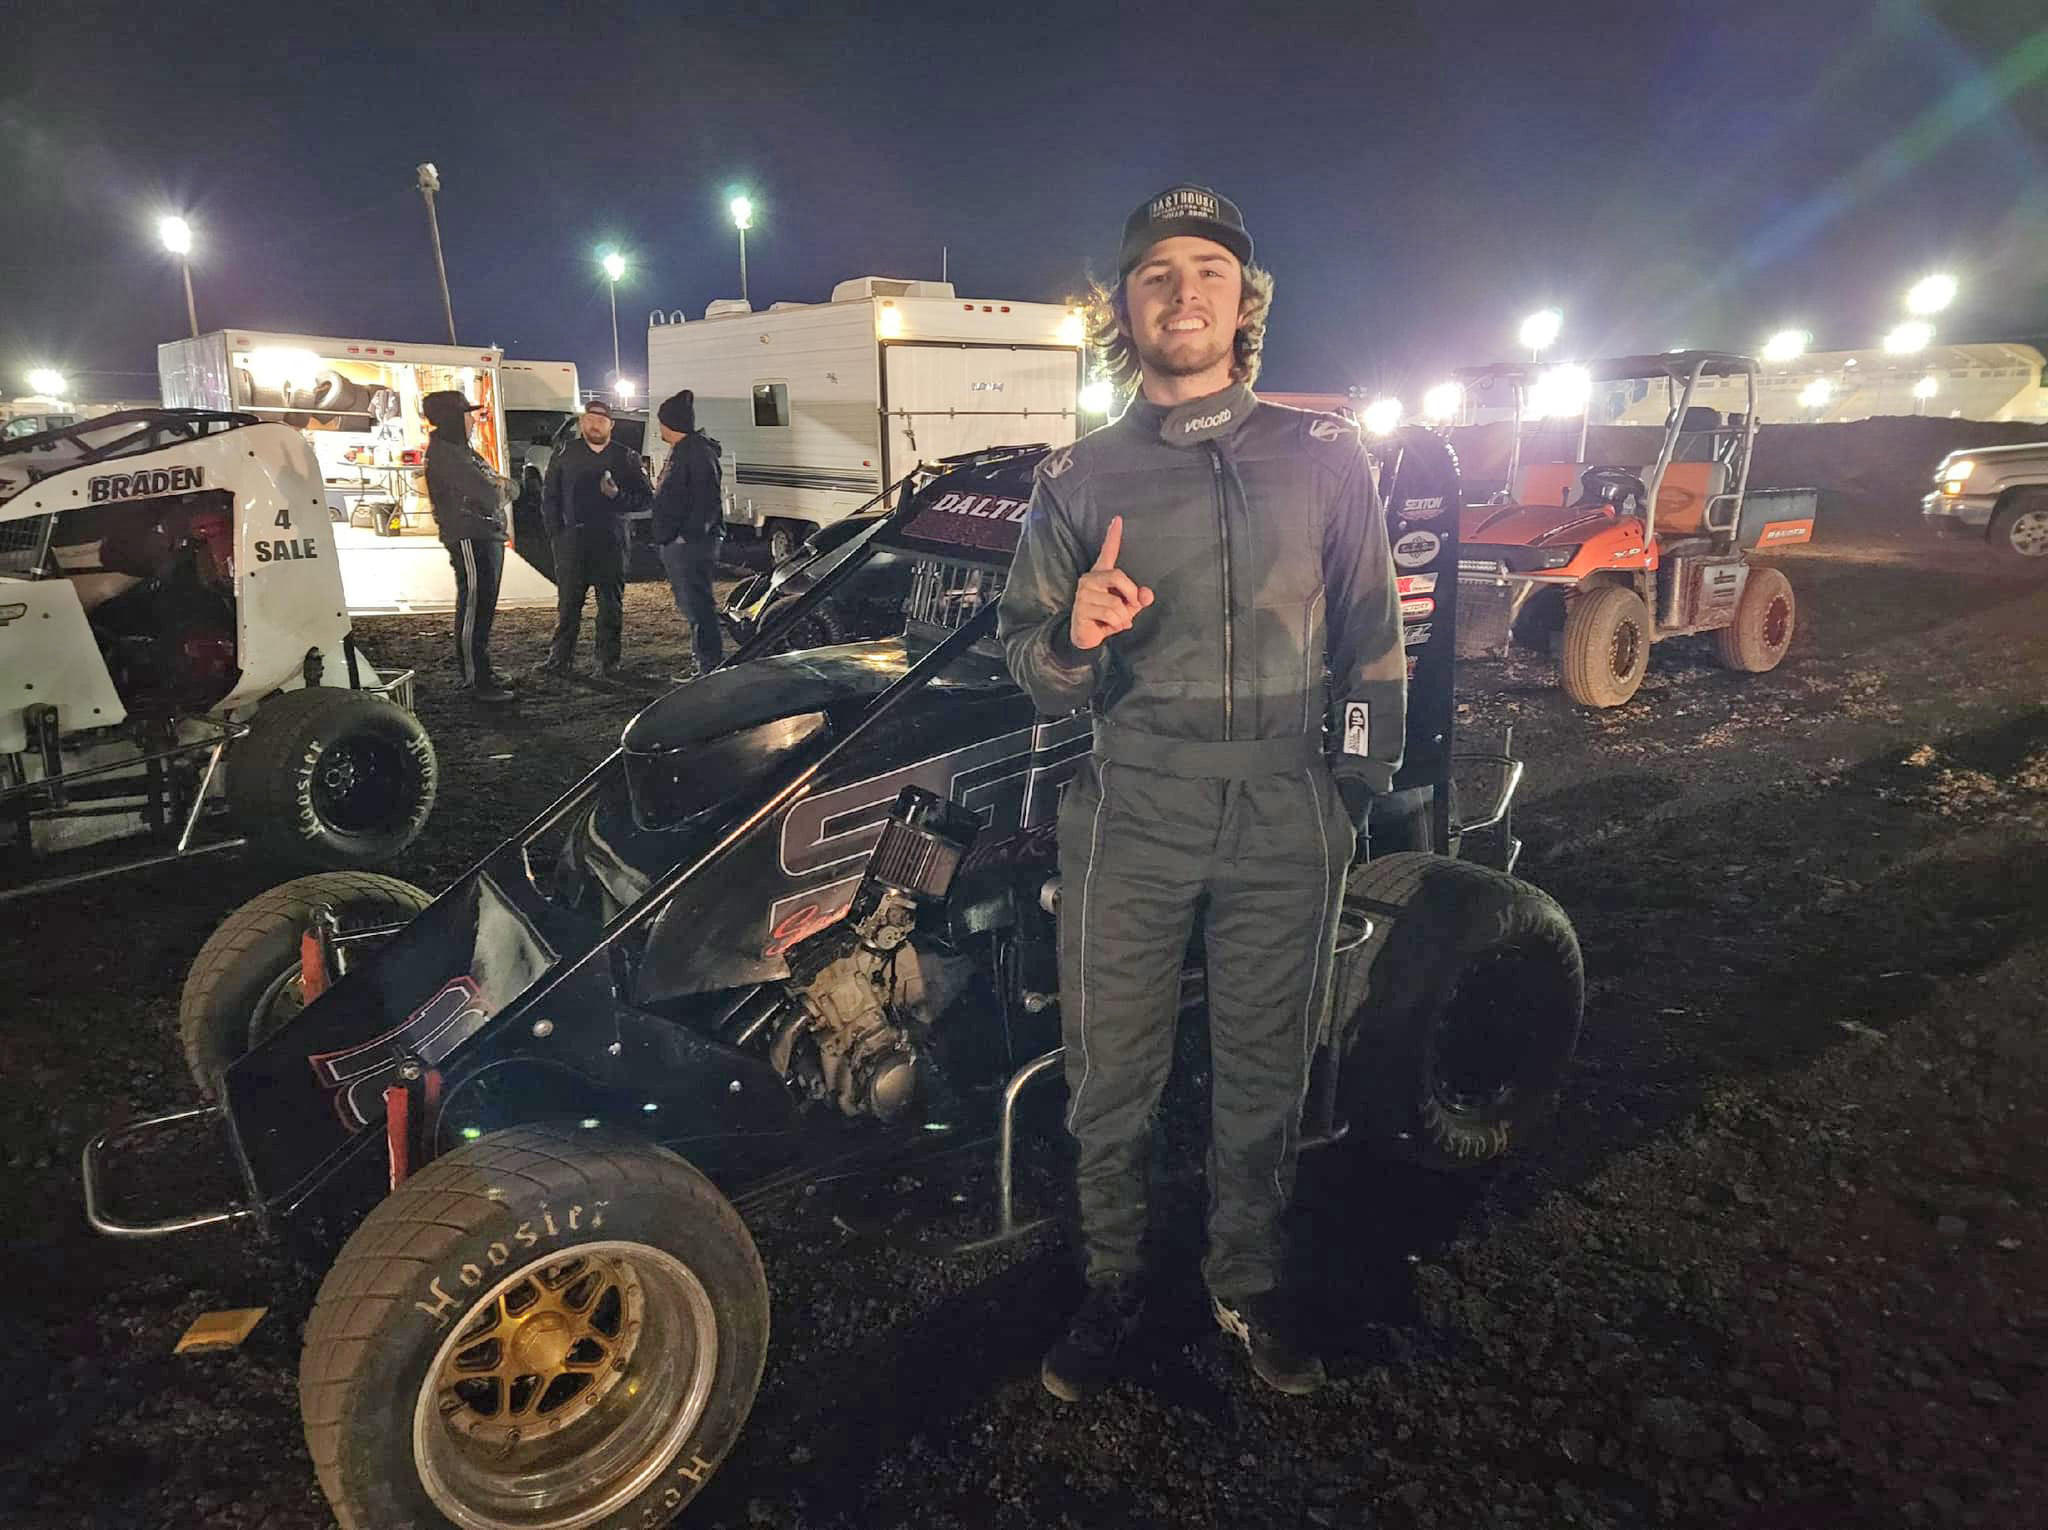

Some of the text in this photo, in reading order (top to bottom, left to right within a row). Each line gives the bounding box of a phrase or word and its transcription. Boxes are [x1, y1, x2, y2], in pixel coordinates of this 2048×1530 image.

[90, 466, 204, 503] BRADEN
[932, 493, 1031, 523] DALTO
[1403, 497, 1443, 512] SEXTON
[274, 509, 292, 530] 4
[255, 538, 318, 562] SALE
[415, 1199, 609, 1333] Hoosier
